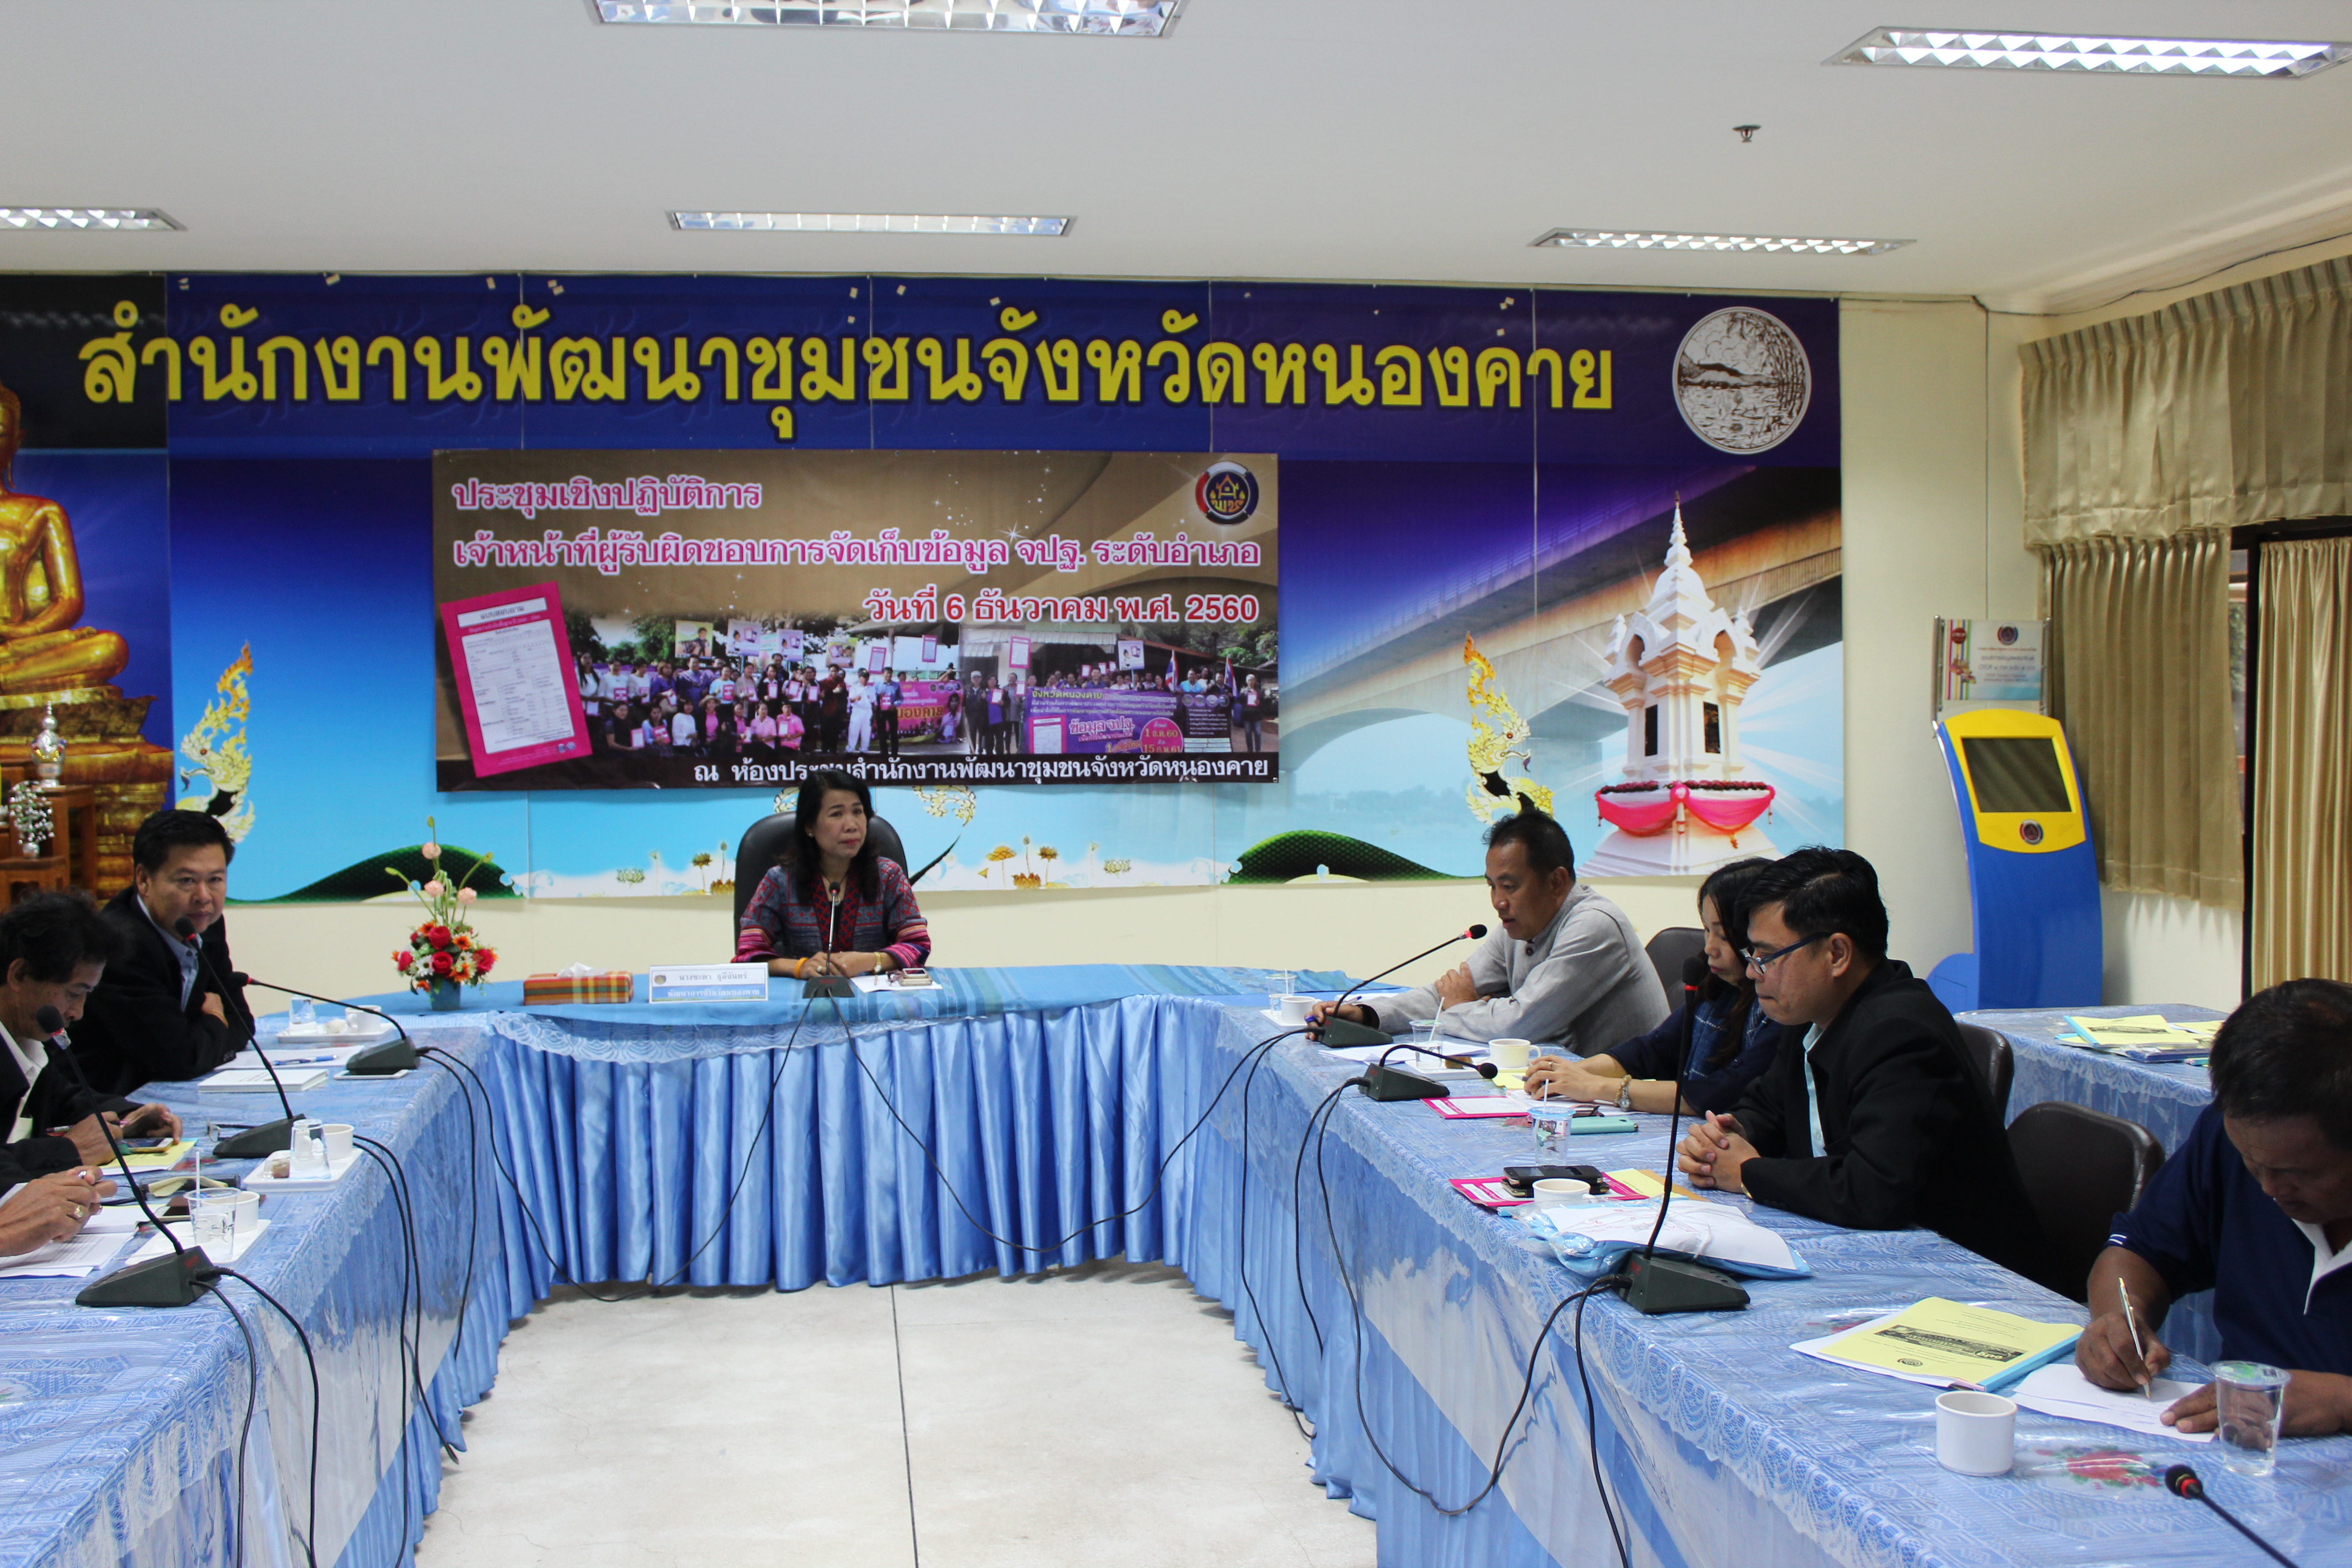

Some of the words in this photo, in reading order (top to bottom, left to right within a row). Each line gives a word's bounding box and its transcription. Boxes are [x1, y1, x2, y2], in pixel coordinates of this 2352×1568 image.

[78, 299, 1613, 439] สำนักงานพัฒนาชุมชนจังหวัดหนองคาย
[452, 475, 761, 518] ประชุมเชิงปฏิบัติการ
[453, 526, 1008, 574] เจ้าหน้าที่ผู้รับผิดชอบการจัดเก็บข้อมูล
[1016, 534, 1086, 572] จปฐ.
[1091, 532, 1260, 566] ระดับอำเภอ
[863, 584, 937, 622] วันที่
[945, 593, 965, 622] 6
[973, 588, 1108, 622] ธันวาคม
[1114, 594, 1179, 622] พ.ศ.
[1185, 594, 1259, 623] 2560
[694, 764, 718, 781] ณ
[731, 755, 1268, 784] ห้องปรสำนักงานพัฒนาชุมชนจังหวัดหนองคาย
